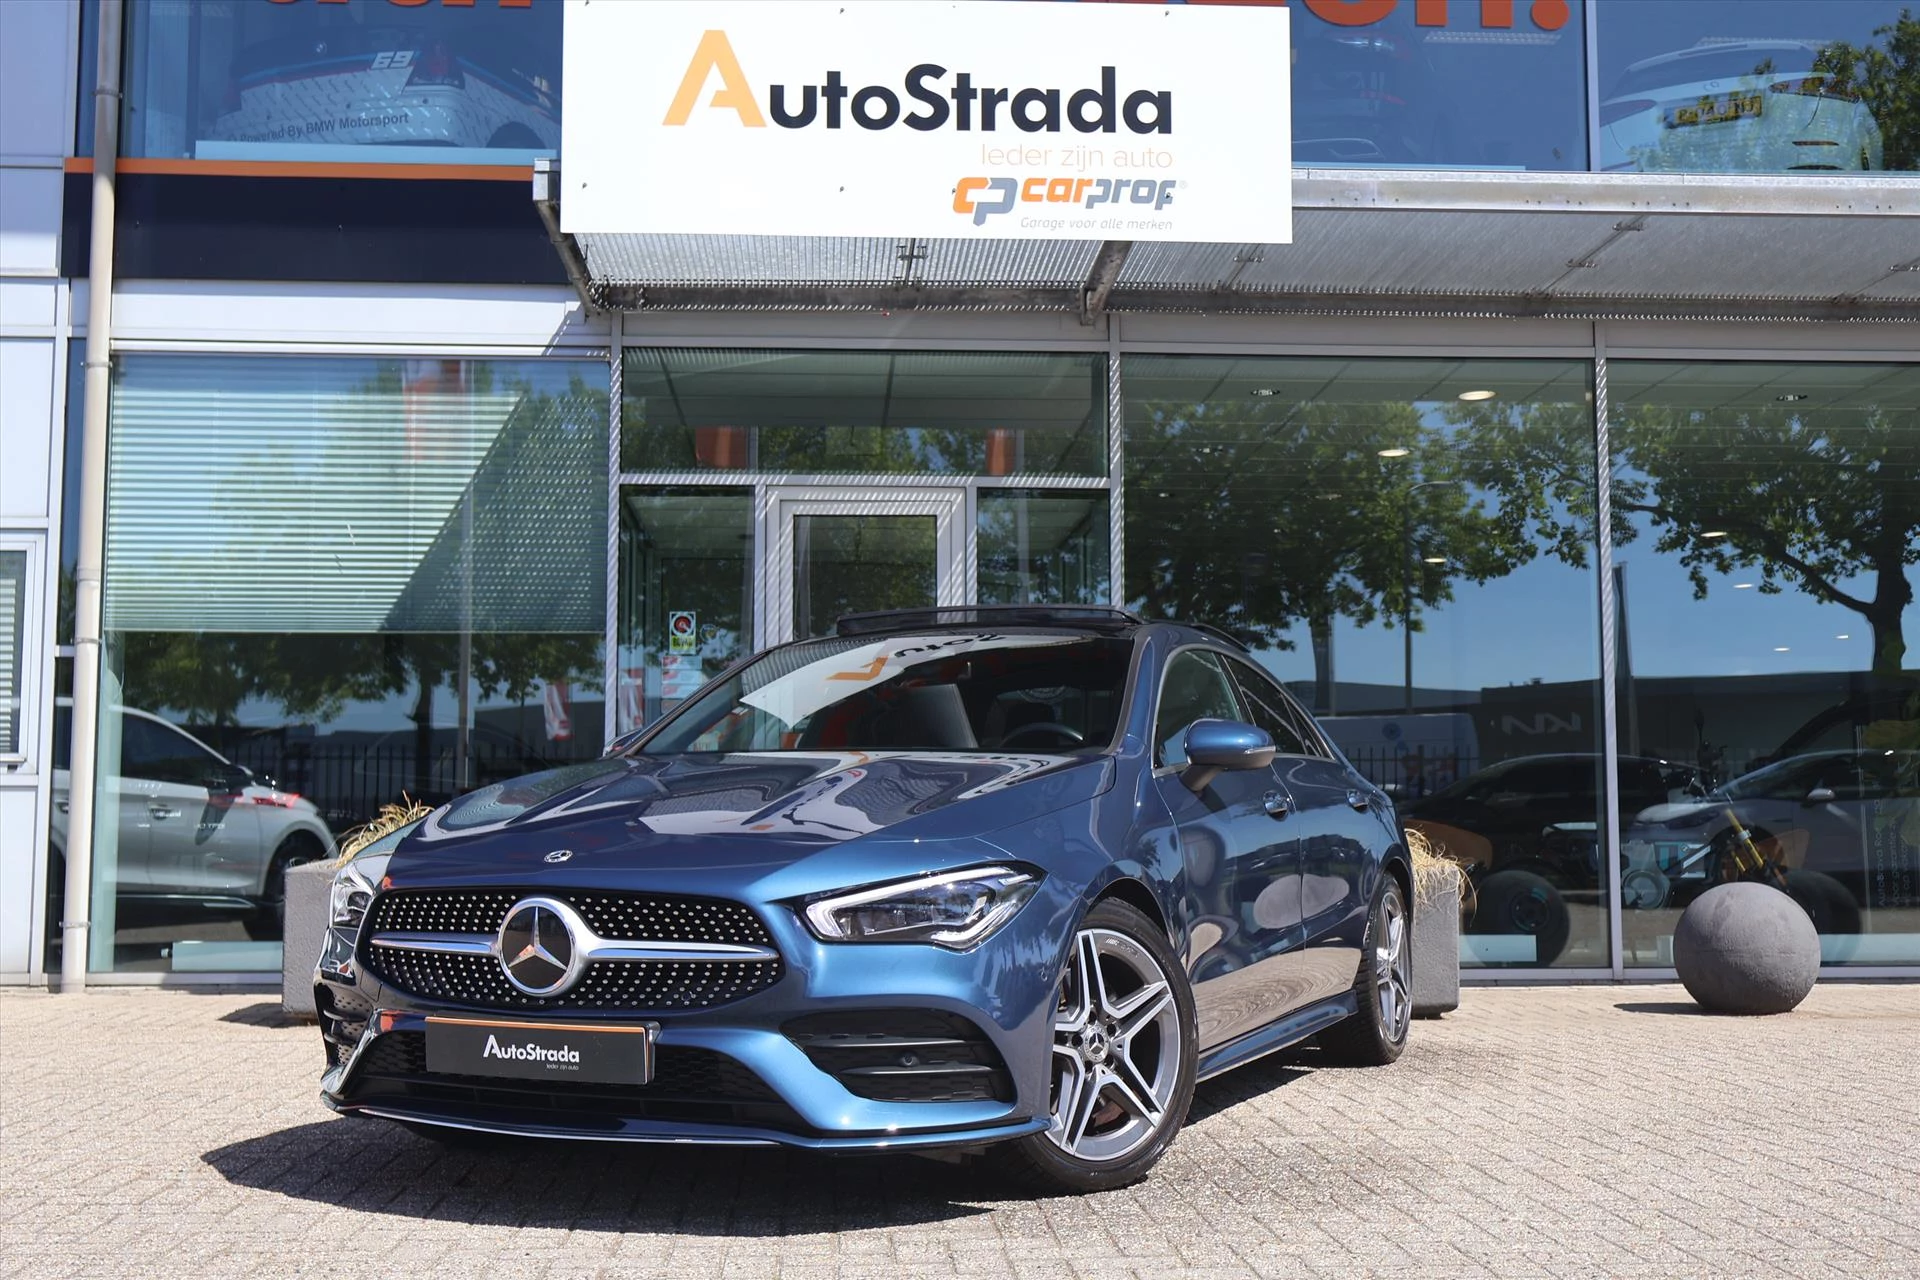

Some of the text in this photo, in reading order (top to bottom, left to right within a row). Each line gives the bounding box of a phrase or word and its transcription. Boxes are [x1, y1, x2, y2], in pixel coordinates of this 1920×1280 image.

[370, 51, 414, 70] 69
[662, 29, 1172, 134] AutoStrada
[287, 125, 303, 138] By
[306, 120, 336, 134] BMW
[339, 113, 409, 130] Motorsport
[1061, 145, 1104, 172] zijn
[1113, 148, 1173, 168] auto
[1021, 217, 1173, 231] Garage voor alle merken
[483, 1034, 580, 1063] AutoStrada
